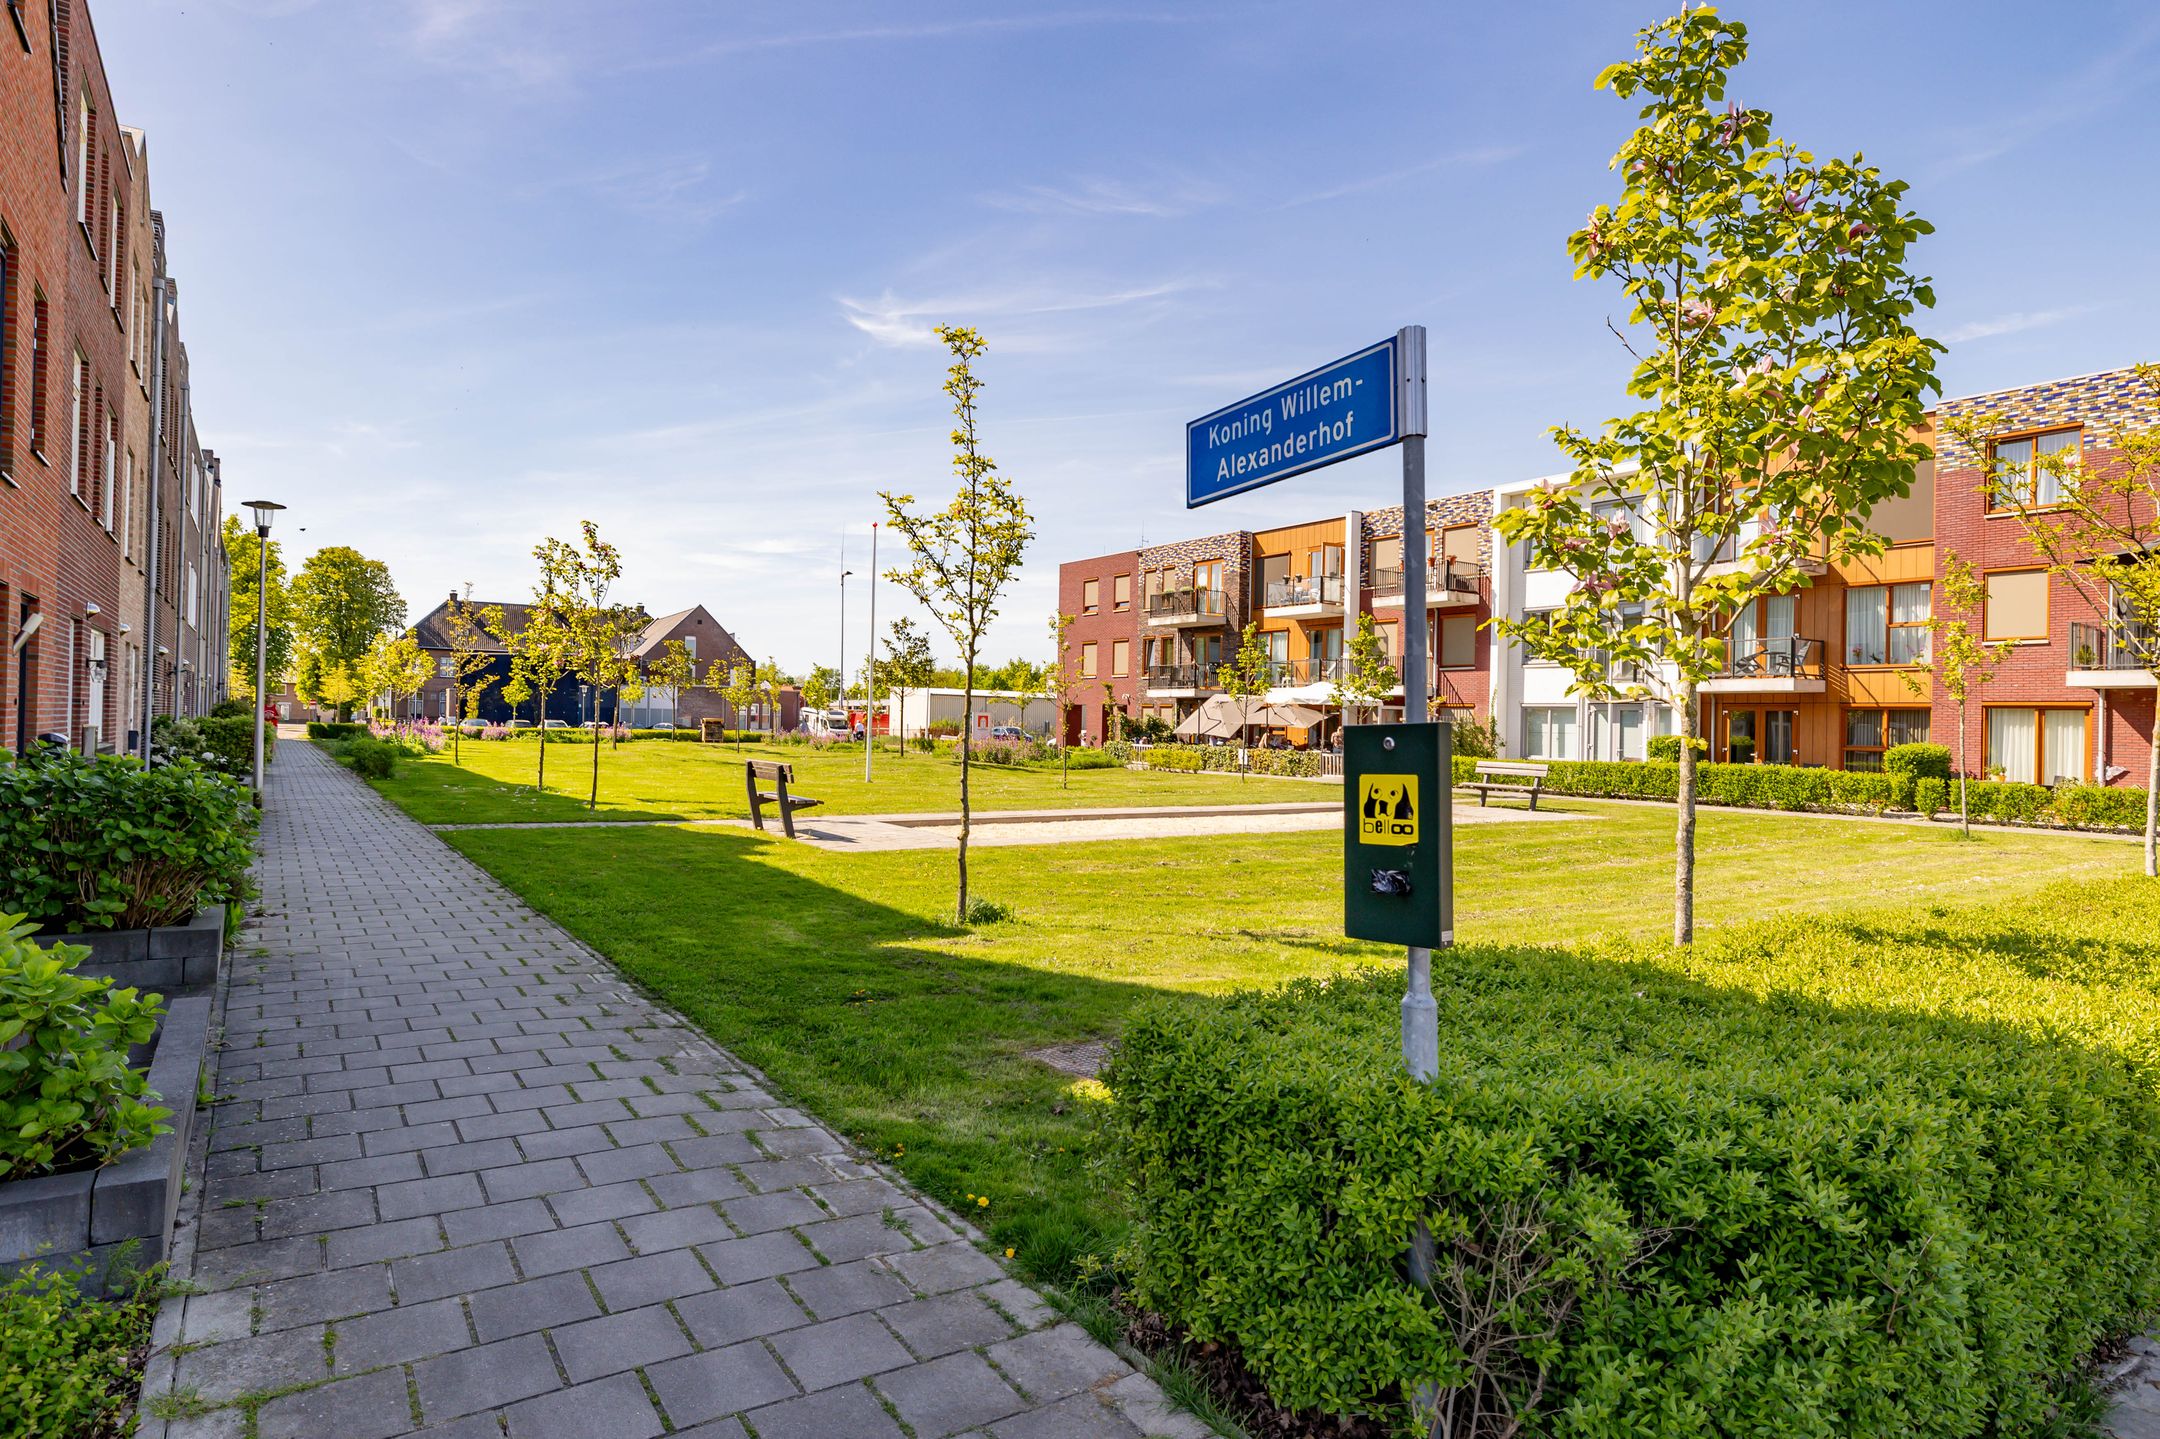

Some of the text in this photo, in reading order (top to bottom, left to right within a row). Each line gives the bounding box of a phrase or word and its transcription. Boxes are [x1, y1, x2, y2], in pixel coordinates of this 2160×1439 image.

[1209, 377, 1363, 449] Koning Willem-
[1217, 411, 1354, 482] Alexanderhof
